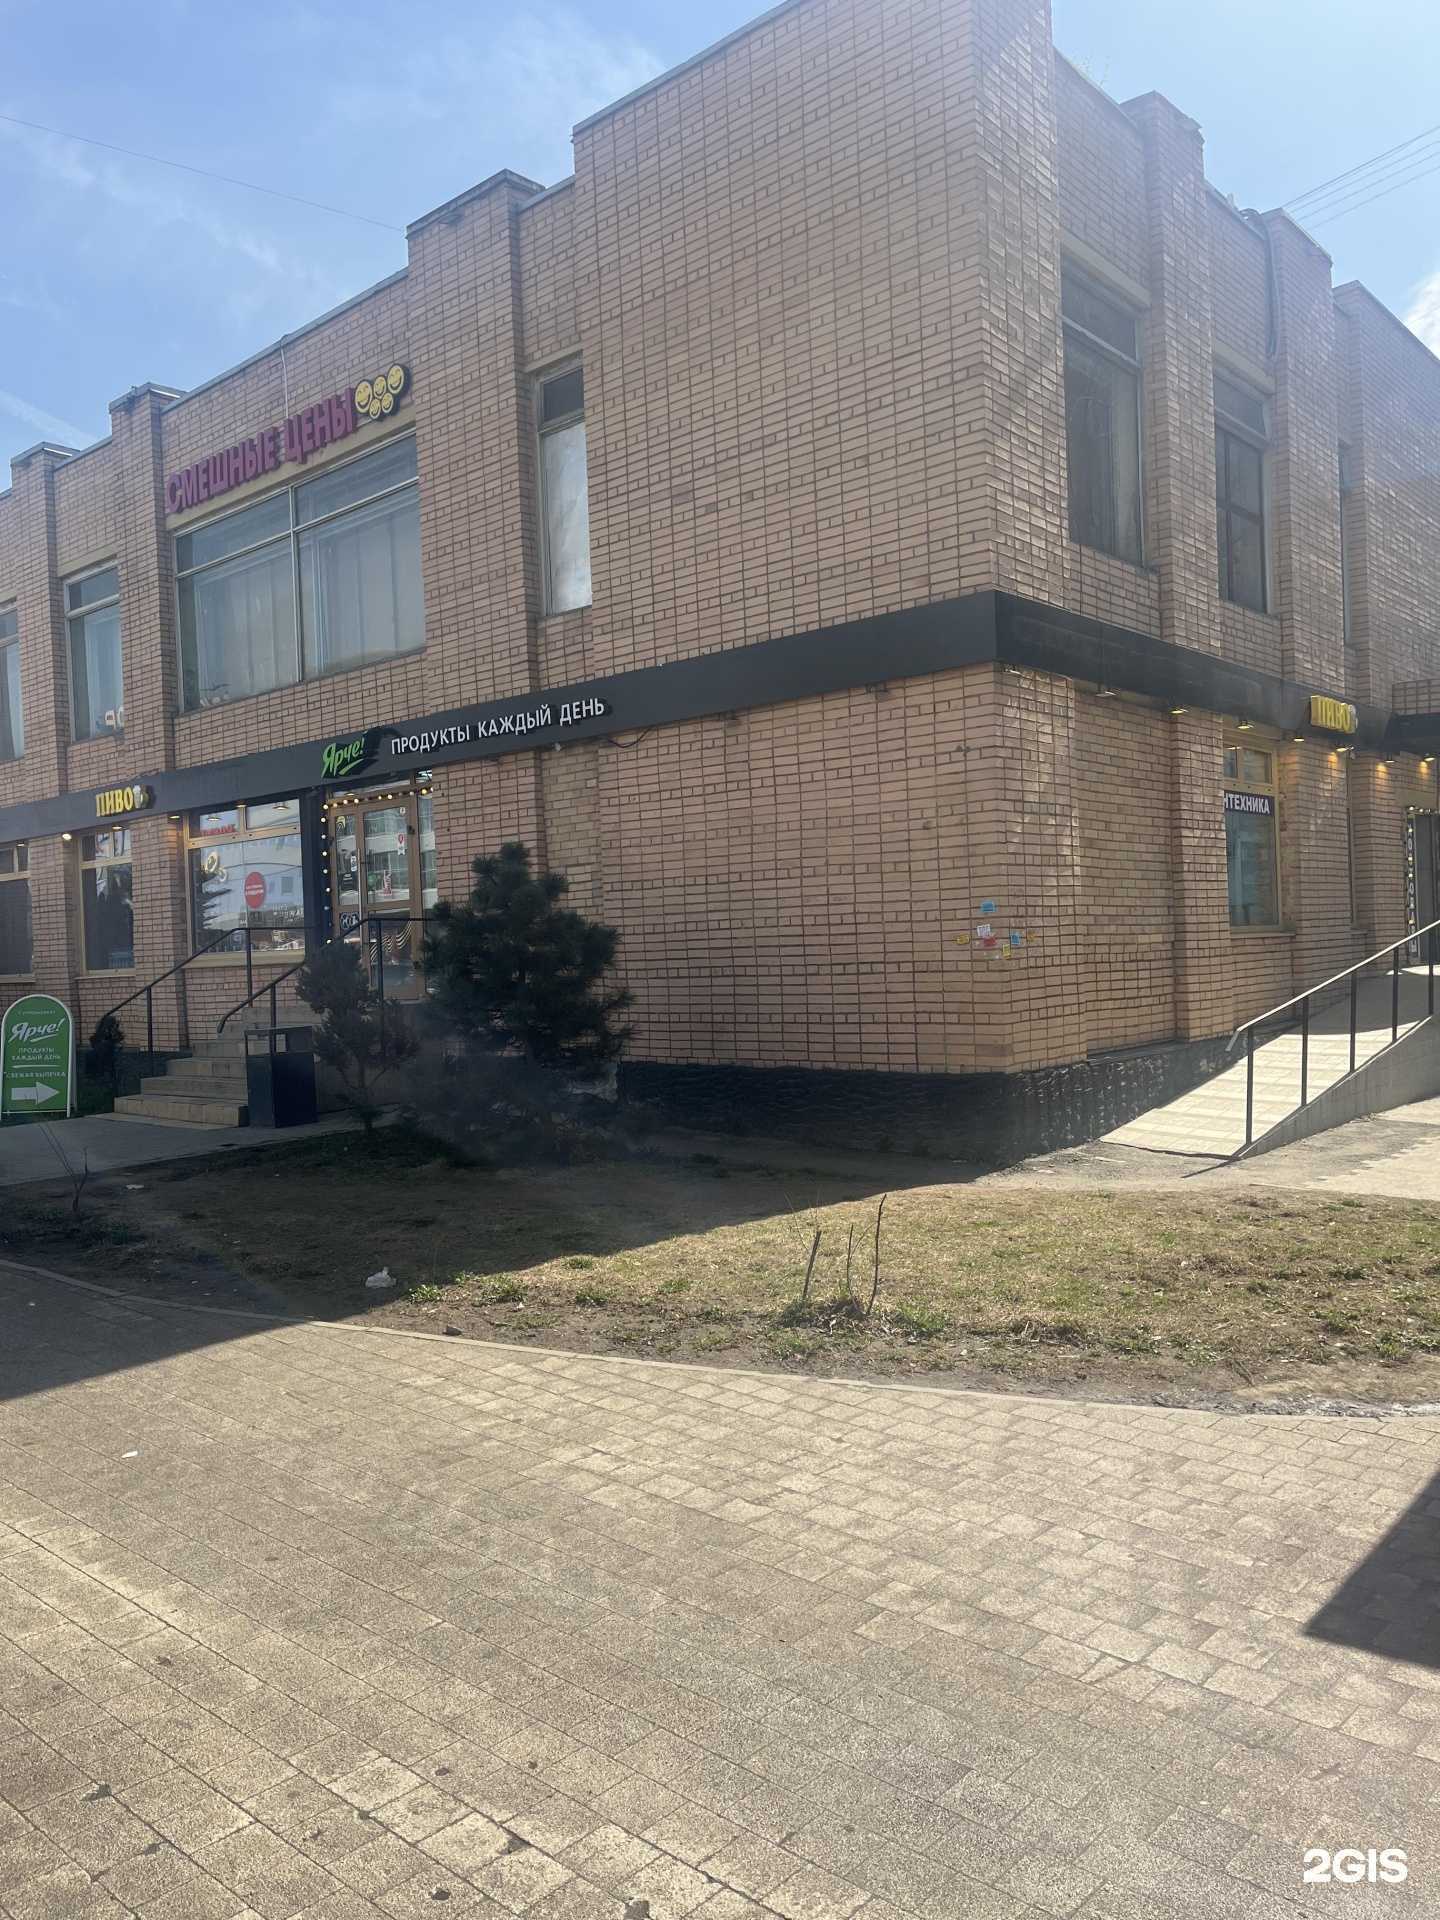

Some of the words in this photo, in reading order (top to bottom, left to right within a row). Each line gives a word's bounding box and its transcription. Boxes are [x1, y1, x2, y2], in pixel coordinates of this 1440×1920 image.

[165, 428, 277, 514] СМЕШНЫЕ
[283, 387, 355, 464] ЦЕНЫ
[391, 724, 470, 755] ПРОДУКТЫ
[478, 704, 552, 738] КАЖДЫЙ
[559, 697, 605, 726] ДЕНЬ
[1311, 696, 1351, 733] ПИВО
[320, 736, 365, 778] Ярче!
[96, 787, 134, 817] ПИВО
[8, 1017, 66, 1043] Ярче!
